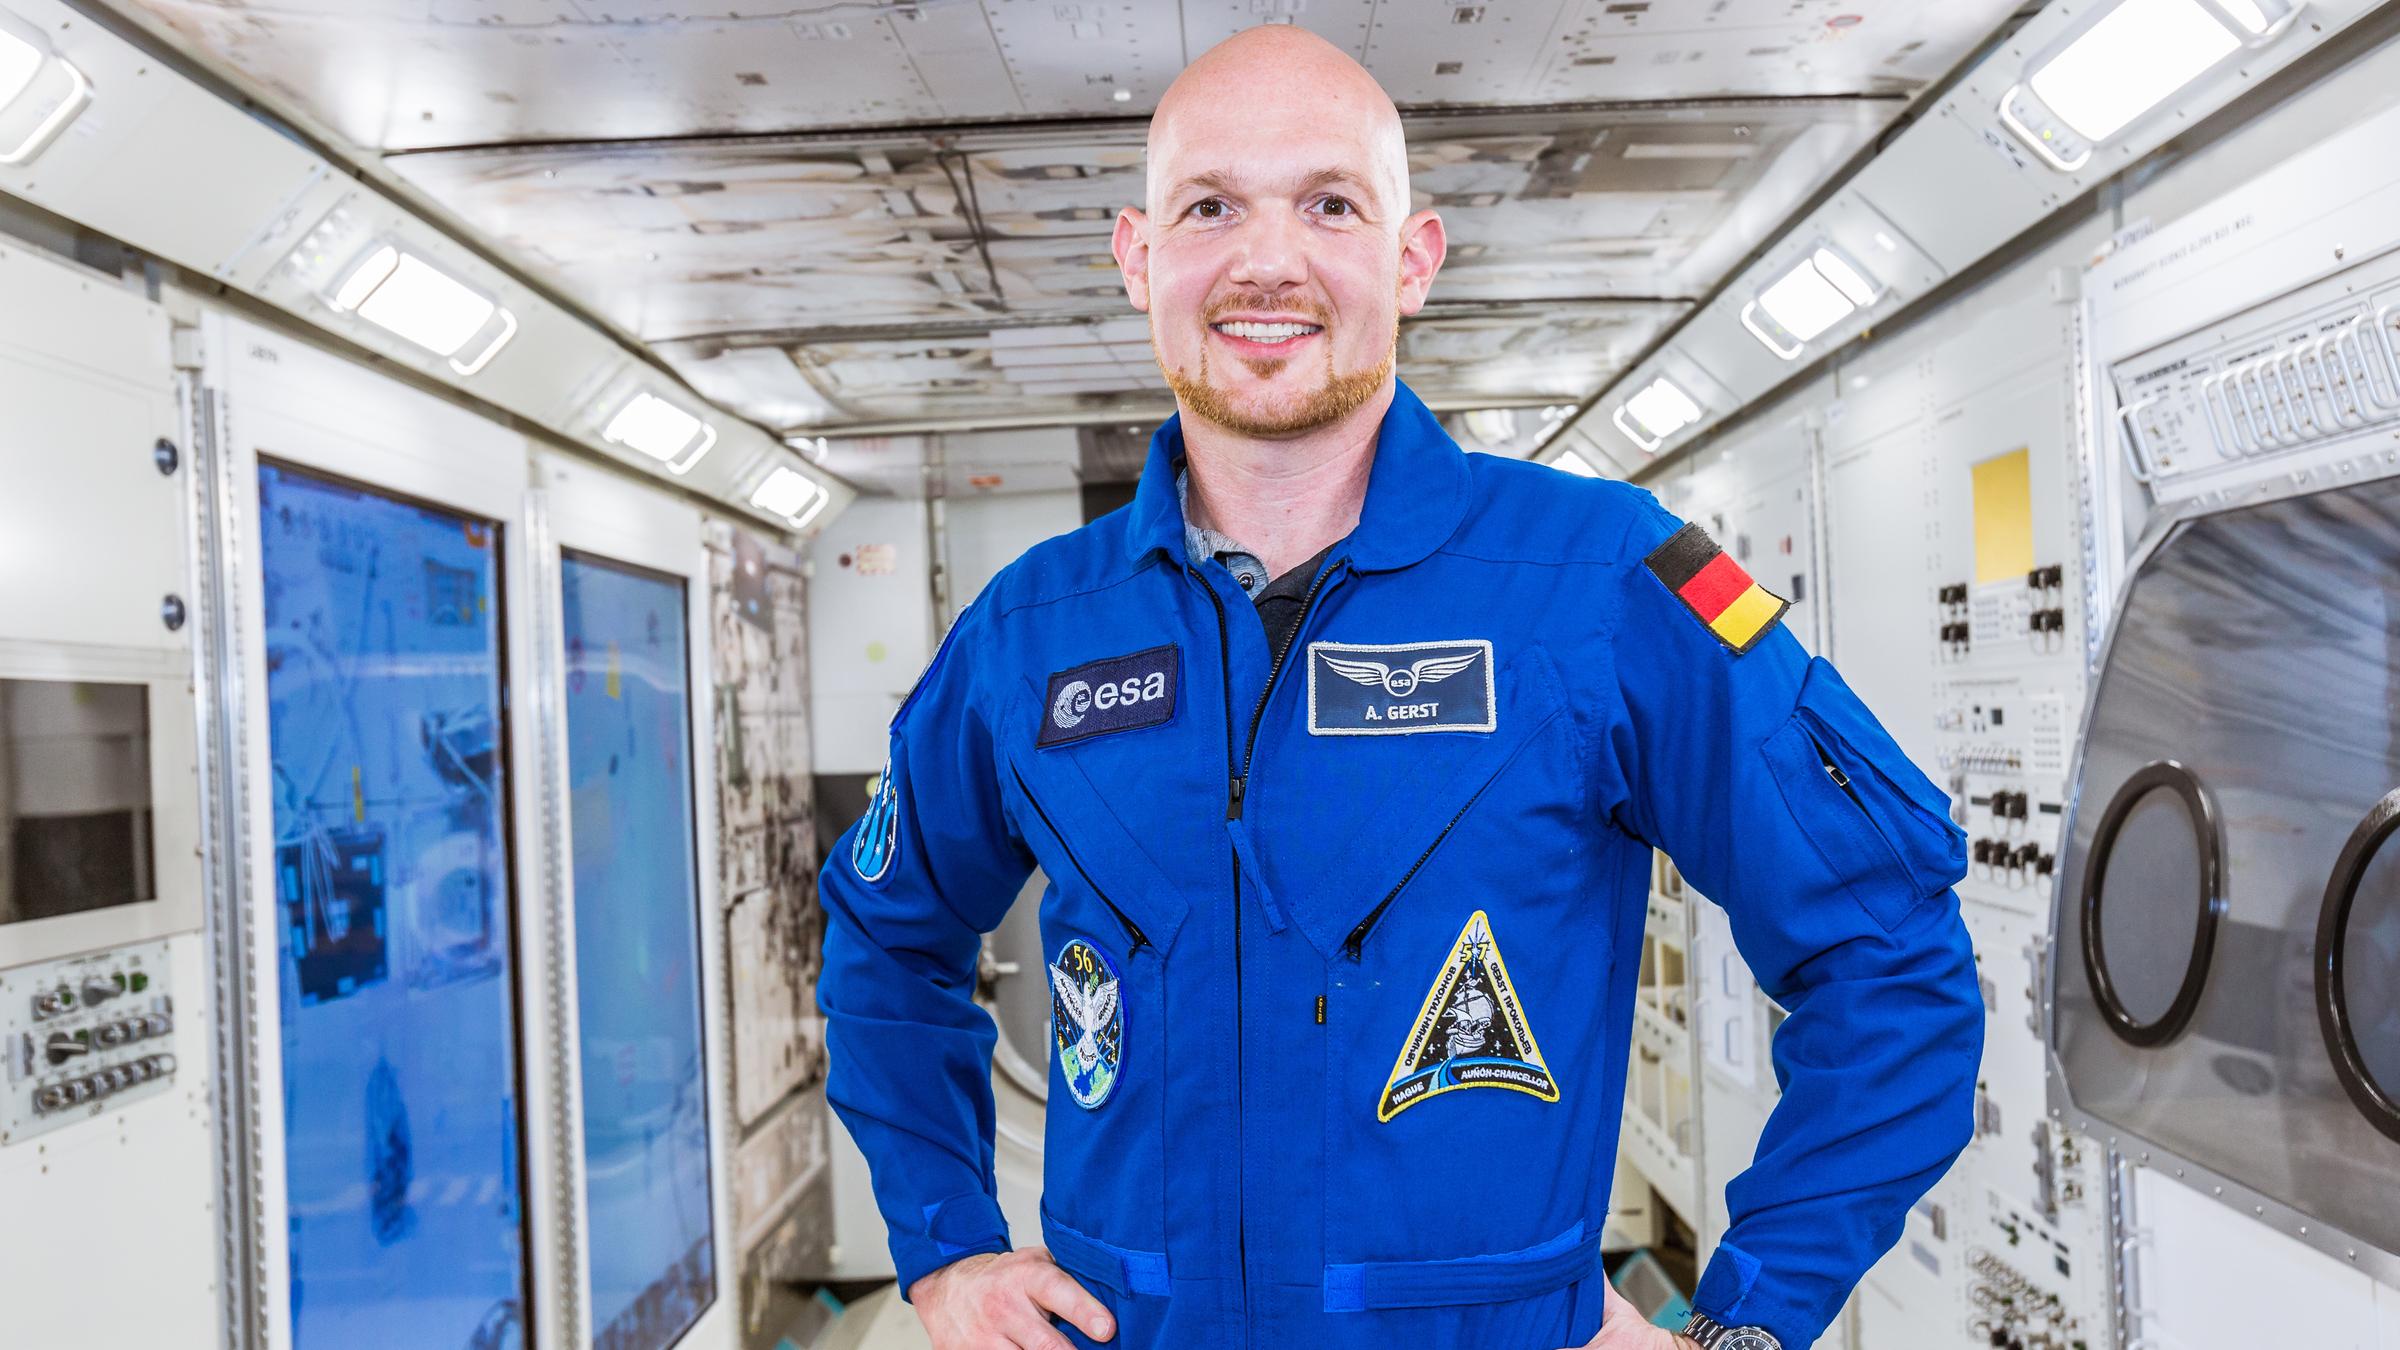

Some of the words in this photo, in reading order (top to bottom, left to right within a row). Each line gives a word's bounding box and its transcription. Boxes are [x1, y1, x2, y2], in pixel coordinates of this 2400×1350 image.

[1095, 671, 1164, 709] esa
[1390, 679, 1411, 687] esa
[1365, 705, 1383, 720] A.
[1387, 702, 1440, 720] GERST
[1073, 945, 1093, 973] 56
[1461, 942, 1489, 962] 57
[1405, 1017, 1432, 1067] ОВЧИНИН
[1427, 966, 1457, 1017] ТИХОНОВ
[1490, 962, 1508, 993] GERST
[1504, 995, 1532, 1055] ПРОКОПЬЕВ
[1392, 1081, 1425, 1105] HAGUE
